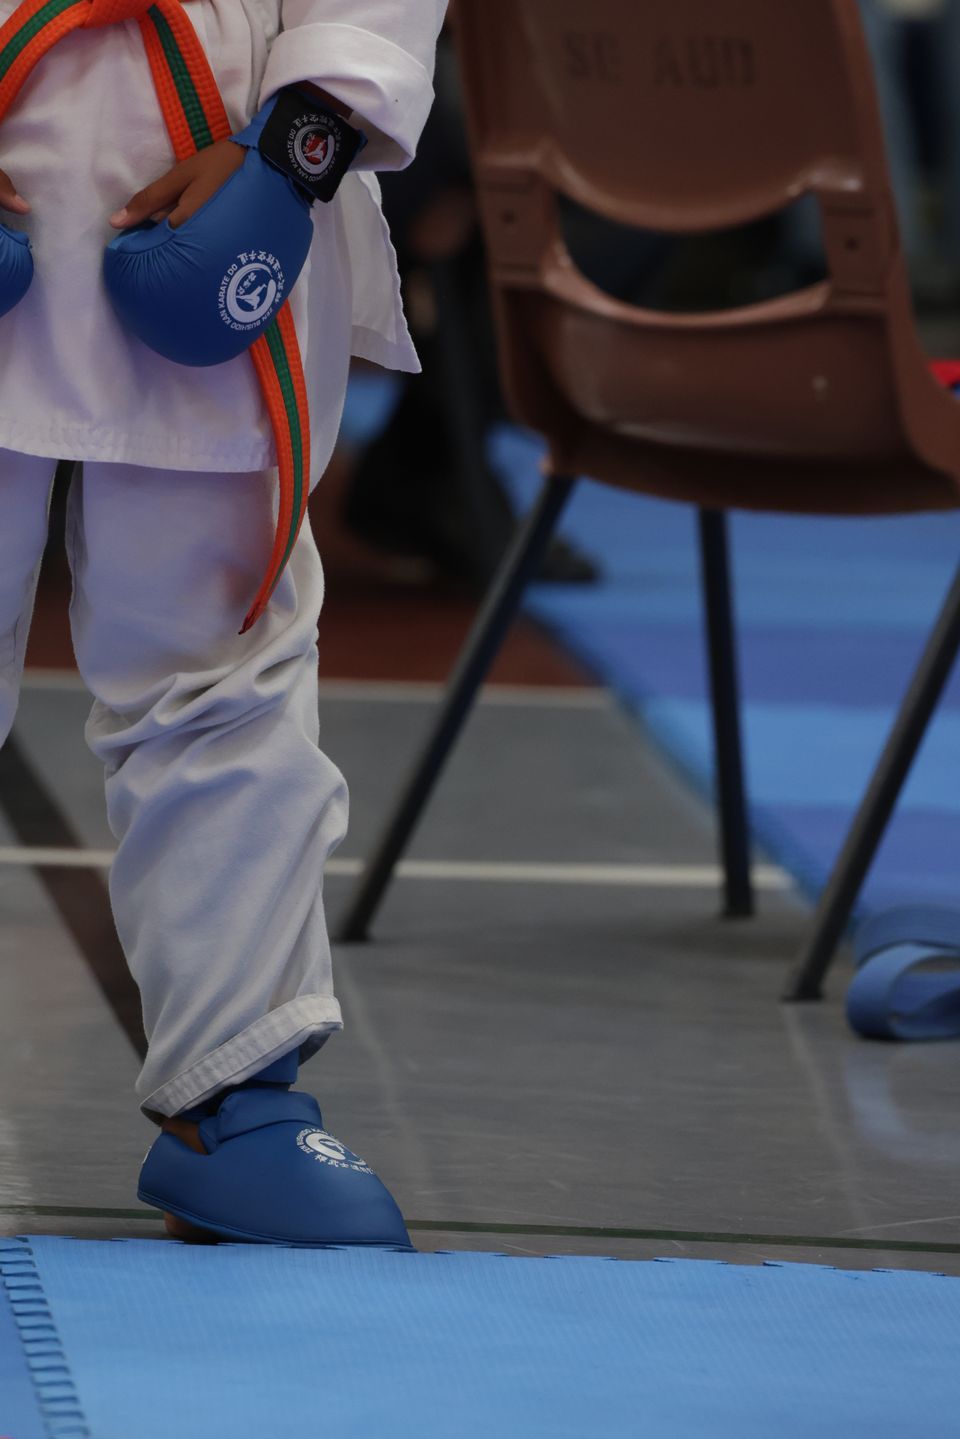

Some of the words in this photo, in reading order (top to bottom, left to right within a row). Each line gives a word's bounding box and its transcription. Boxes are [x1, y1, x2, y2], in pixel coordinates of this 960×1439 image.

[289, 128, 297, 139] DO
[227, 263, 238, 276] DO
[218, 275, 230, 309] KARATE
[220, 309, 232, 325] KAN
[230, 320, 261, 331] BUSHIDO
